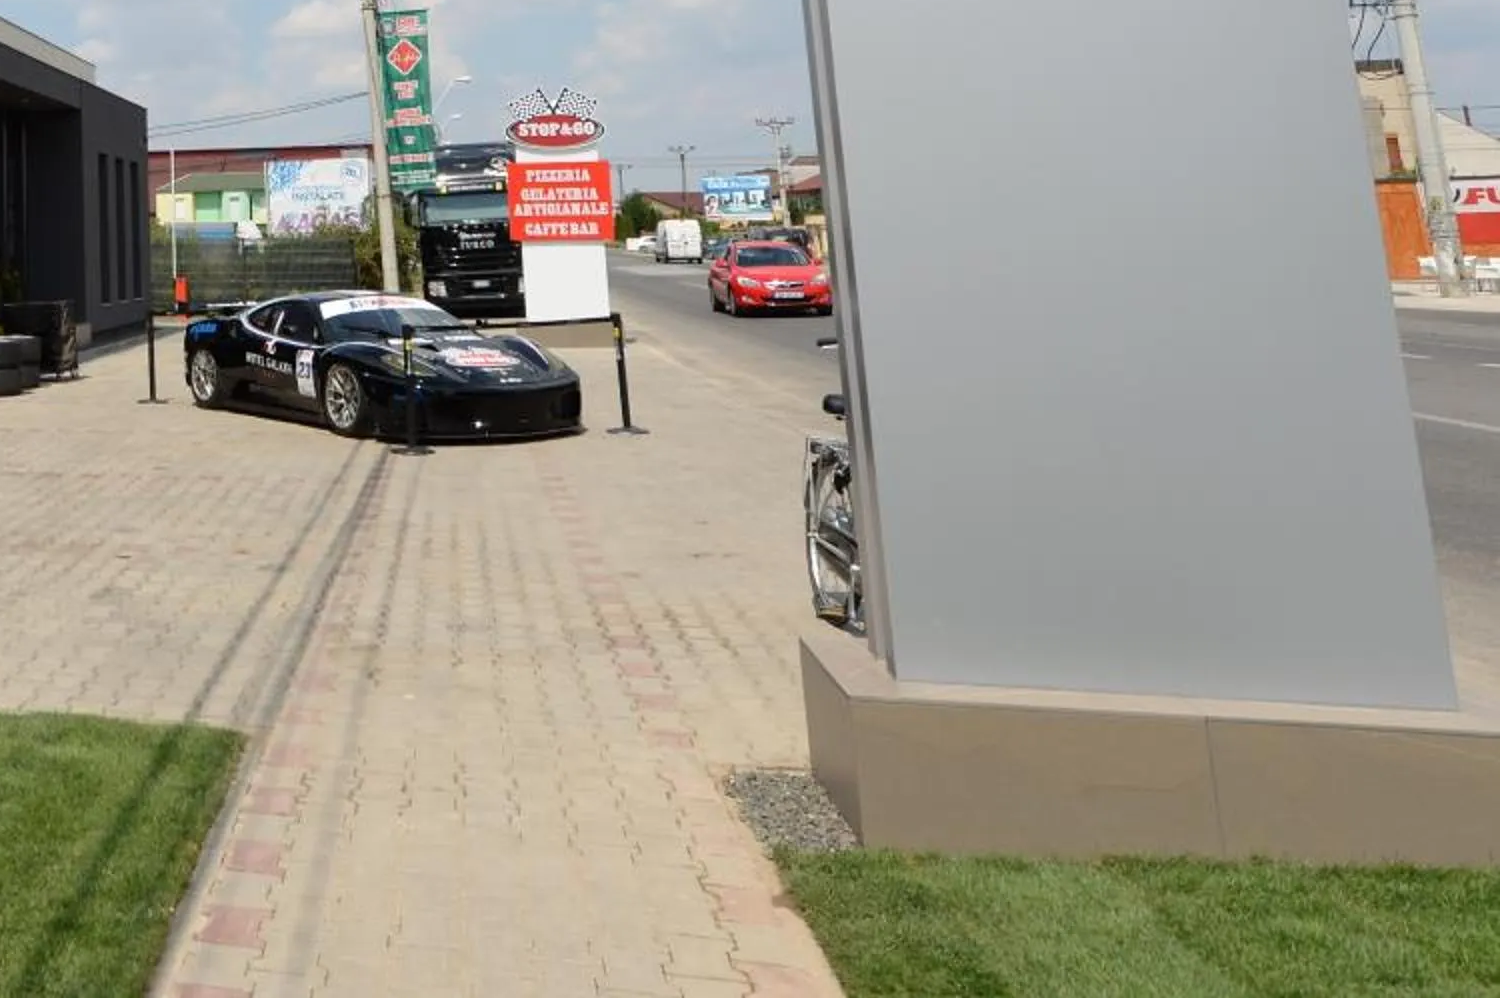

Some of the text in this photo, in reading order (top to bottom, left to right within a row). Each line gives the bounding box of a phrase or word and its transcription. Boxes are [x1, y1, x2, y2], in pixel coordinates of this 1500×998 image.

[519, 122, 595, 136] STOP&GO
[525, 168, 591, 183] PIZZERIA
[519, 187, 599, 201] GELATERIA
[513, 201, 610, 217] ARTIGIANALE
[459, 239, 495, 250] IVECO
[245, 352, 264, 367] HOTEL
